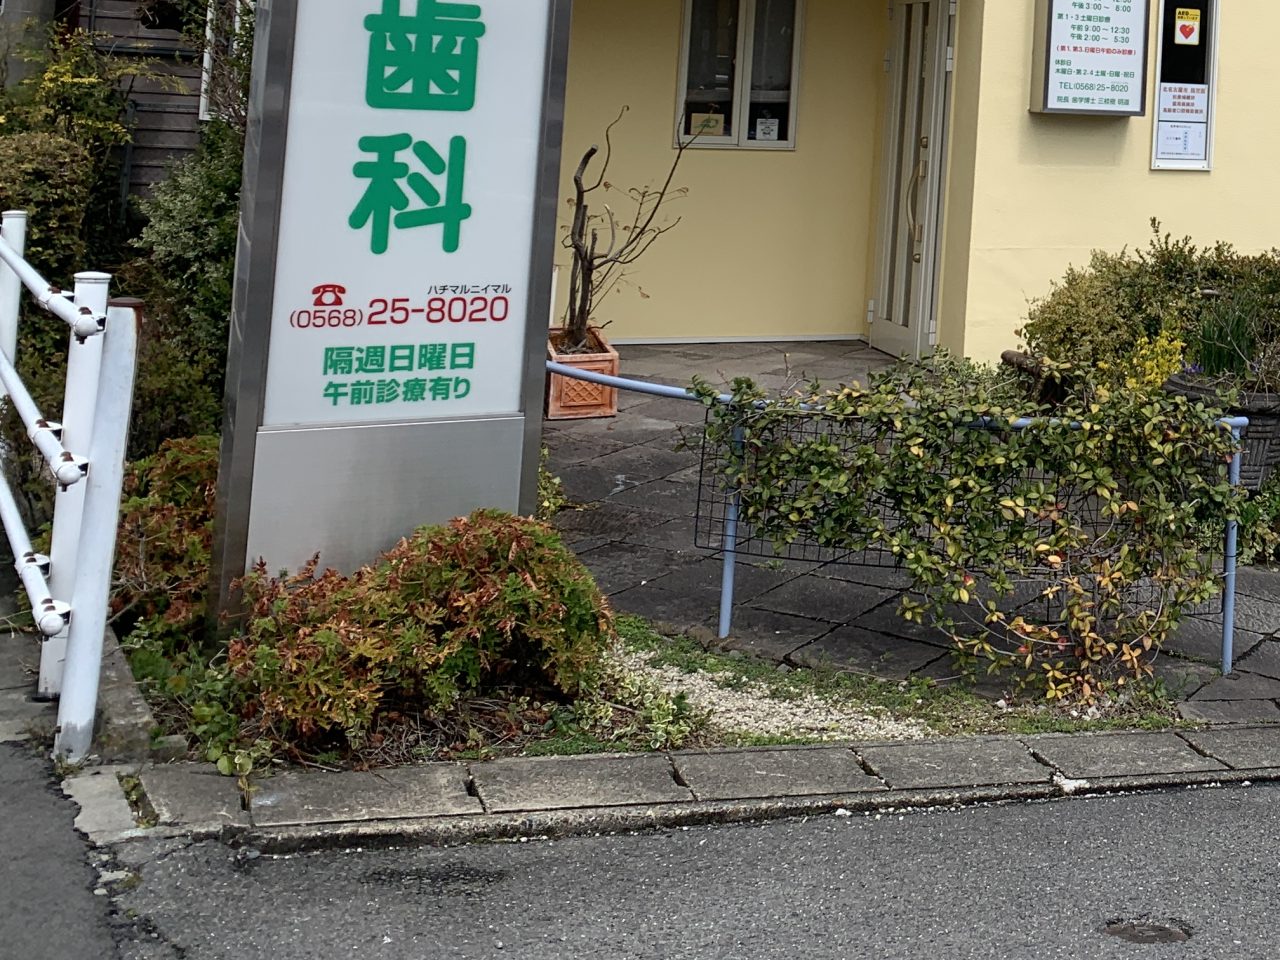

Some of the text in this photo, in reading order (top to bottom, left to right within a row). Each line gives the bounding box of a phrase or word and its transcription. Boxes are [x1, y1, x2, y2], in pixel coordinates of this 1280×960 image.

[427, 283, 512, 295] ハチマルニイマル
[322, 342, 476, 376] 隔週日曜日
[322, 376, 472, 406] 午前診療有り
